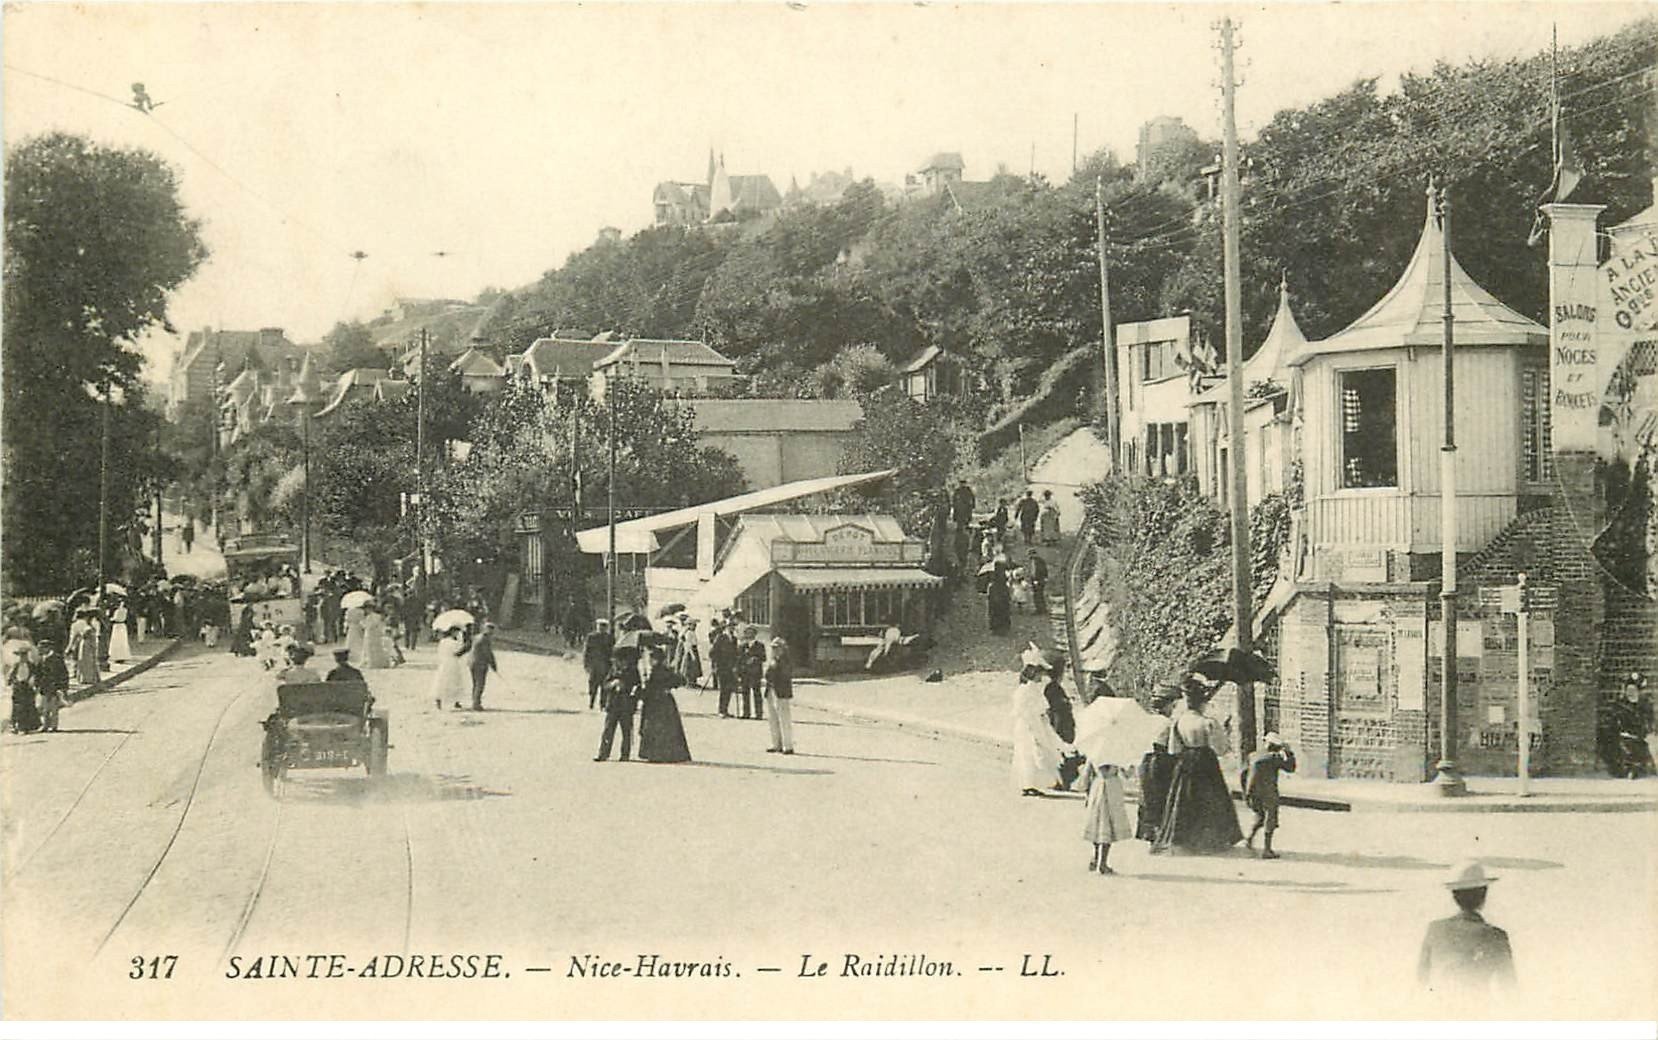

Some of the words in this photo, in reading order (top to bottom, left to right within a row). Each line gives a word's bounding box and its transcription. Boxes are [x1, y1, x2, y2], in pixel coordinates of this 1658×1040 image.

[1610, 265, 1657, 306] ANCIE
[1555, 303, 1597, 323] SALONS
[1555, 345, 1597, 366] NOCES
